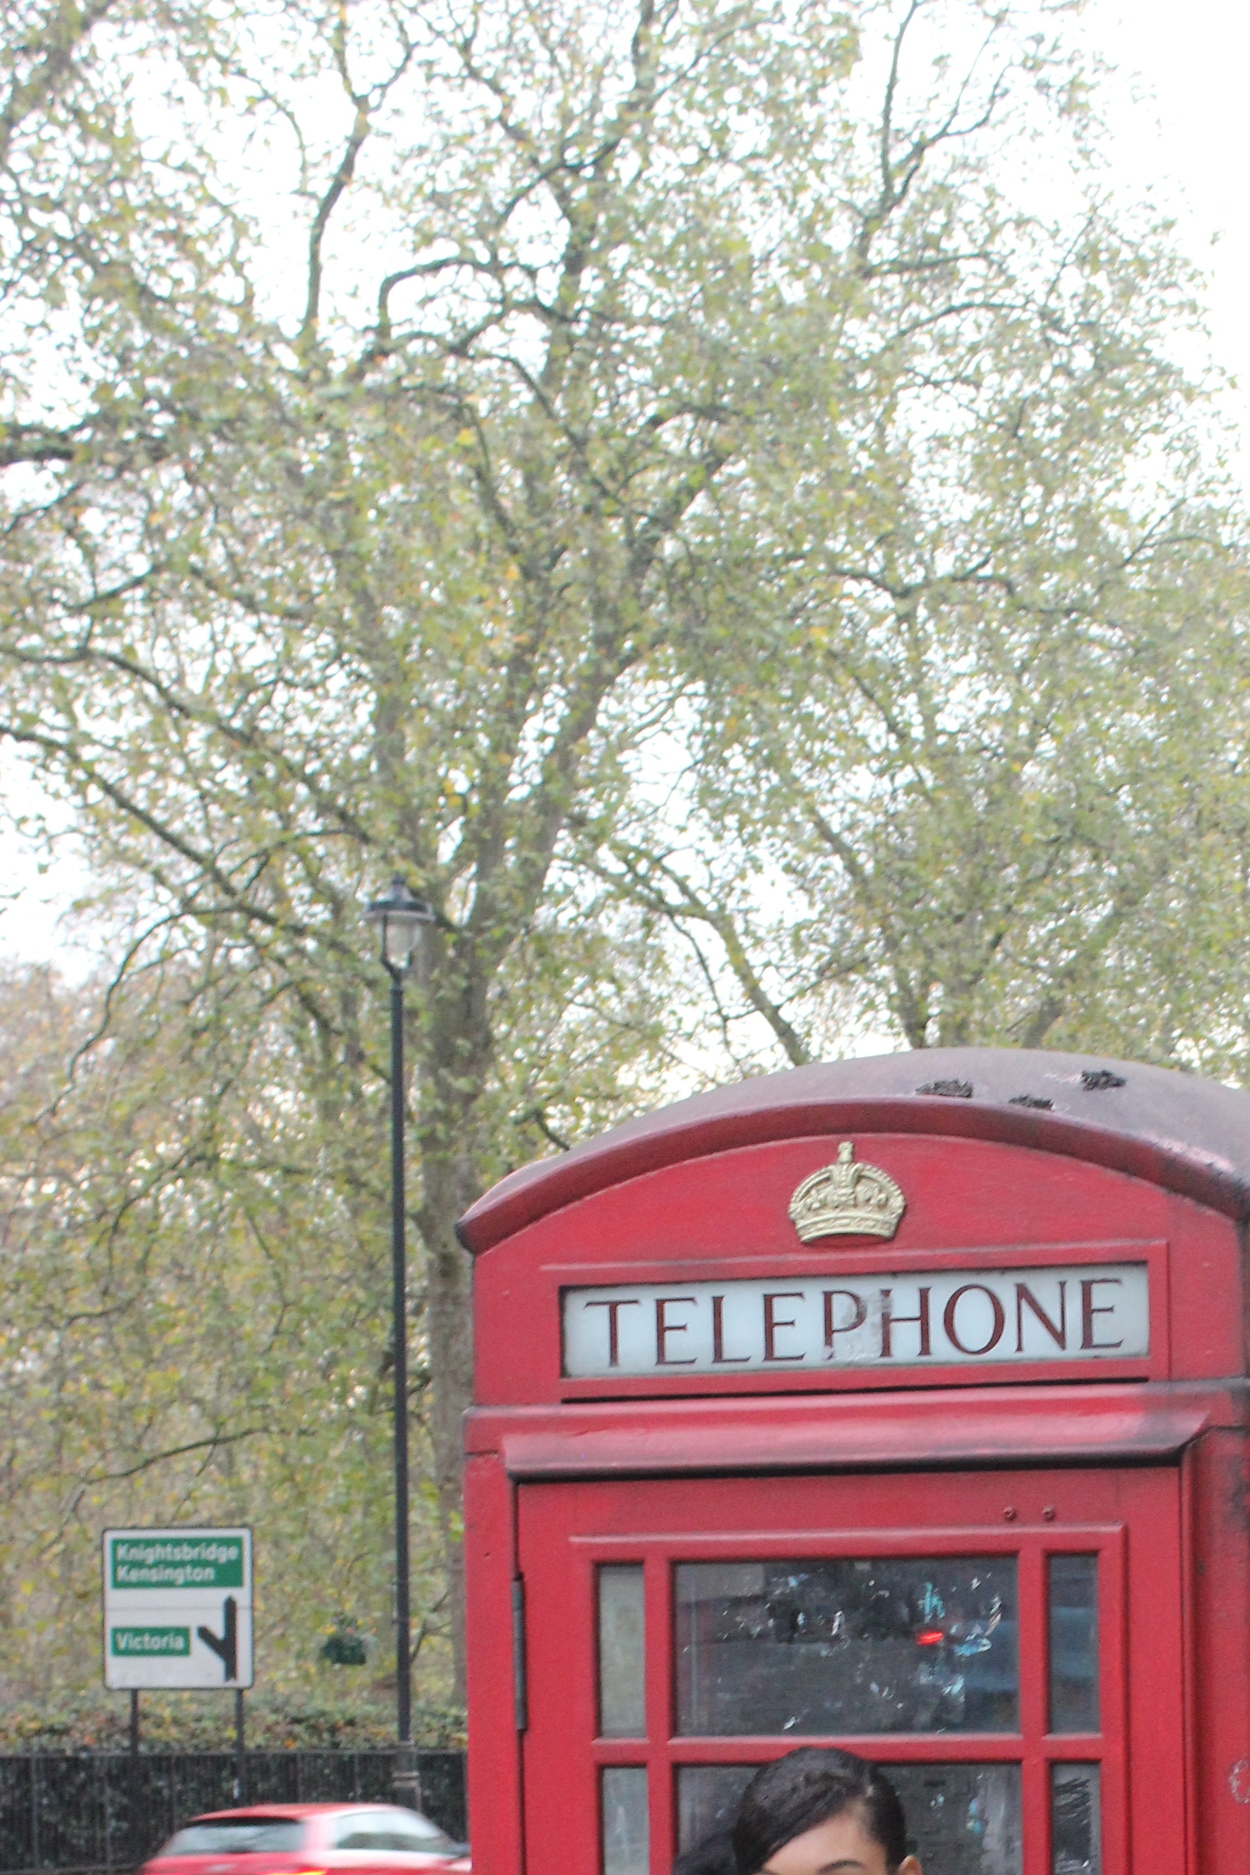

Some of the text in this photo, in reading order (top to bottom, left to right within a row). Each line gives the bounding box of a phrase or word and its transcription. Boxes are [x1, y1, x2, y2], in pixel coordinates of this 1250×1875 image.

[584, 1278, 1125, 1368] TELEPHONE
[116, 1543, 239, 1564] Knightsbridge
[116, 1565, 216, 1585] Kensington
[116, 1633, 185, 1650] Victoria
